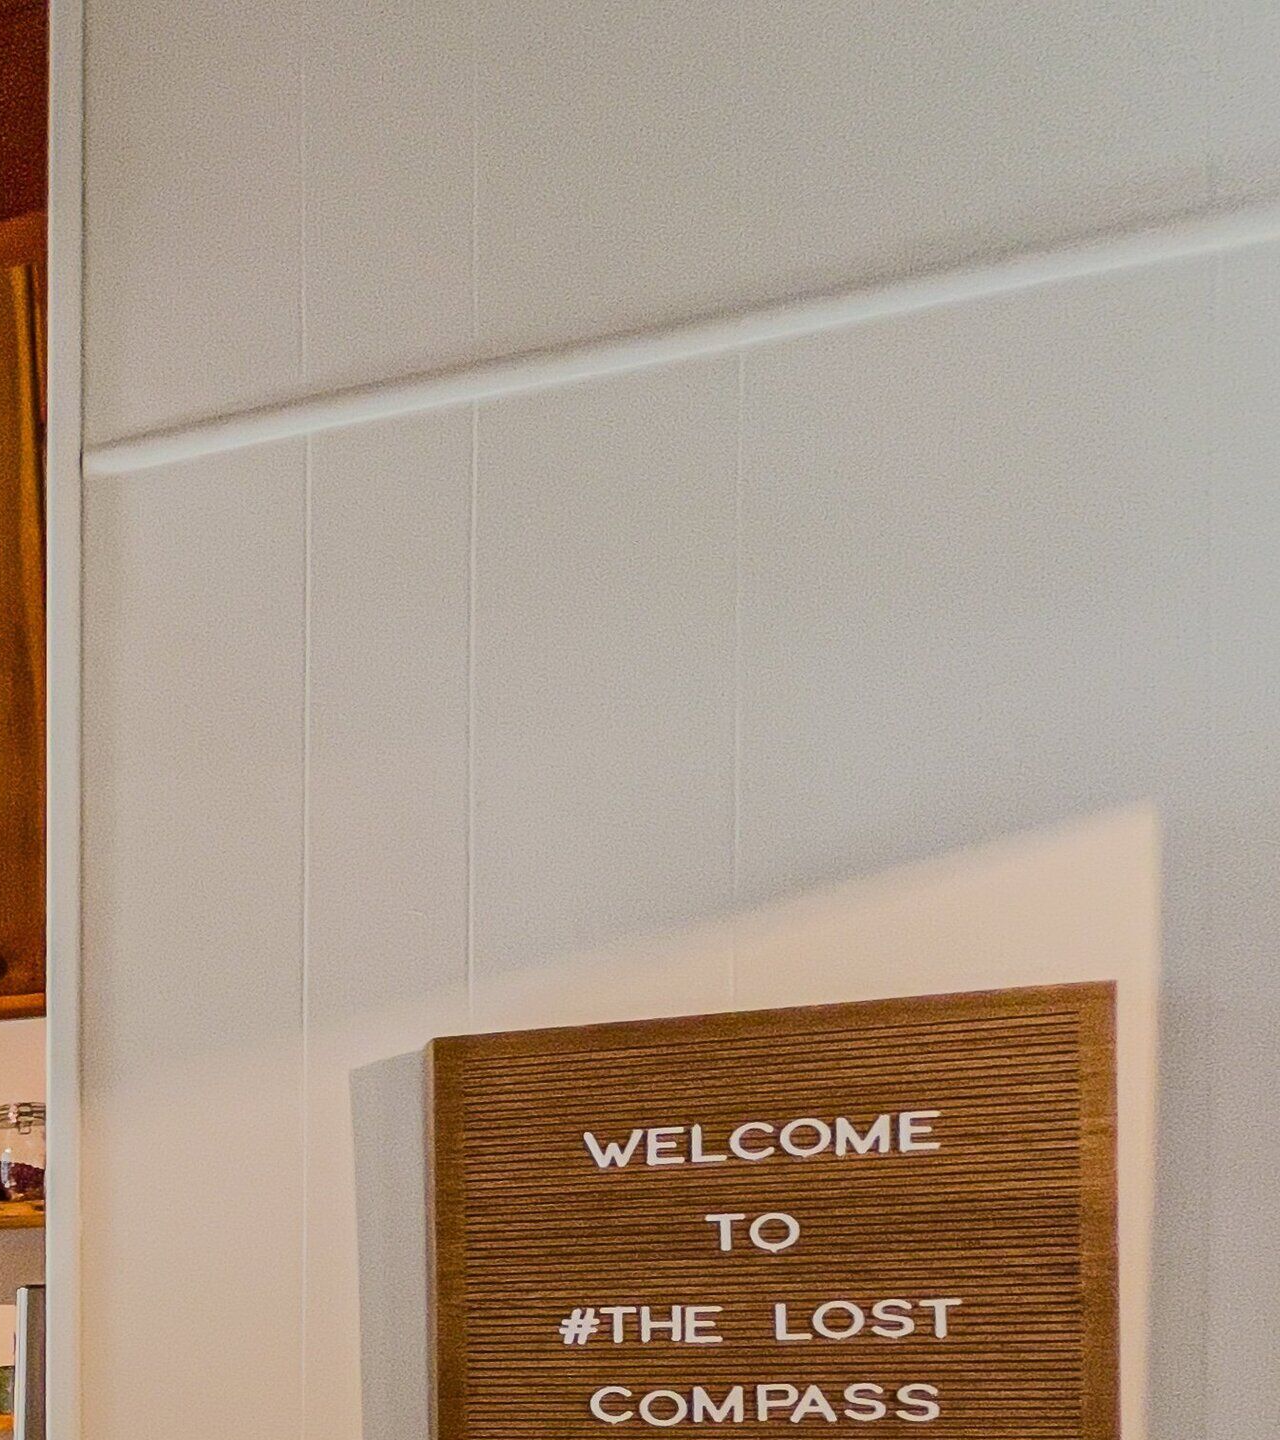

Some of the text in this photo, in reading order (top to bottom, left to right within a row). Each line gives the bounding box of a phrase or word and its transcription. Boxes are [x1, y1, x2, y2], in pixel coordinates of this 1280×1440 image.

[582, 1110, 942, 1170] WELCOME
[704, 1212, 801, 1254] TO
[557, 1297, 963, 1346] #THE LOST
[589, 1382, 941, 1428] COMPASS
